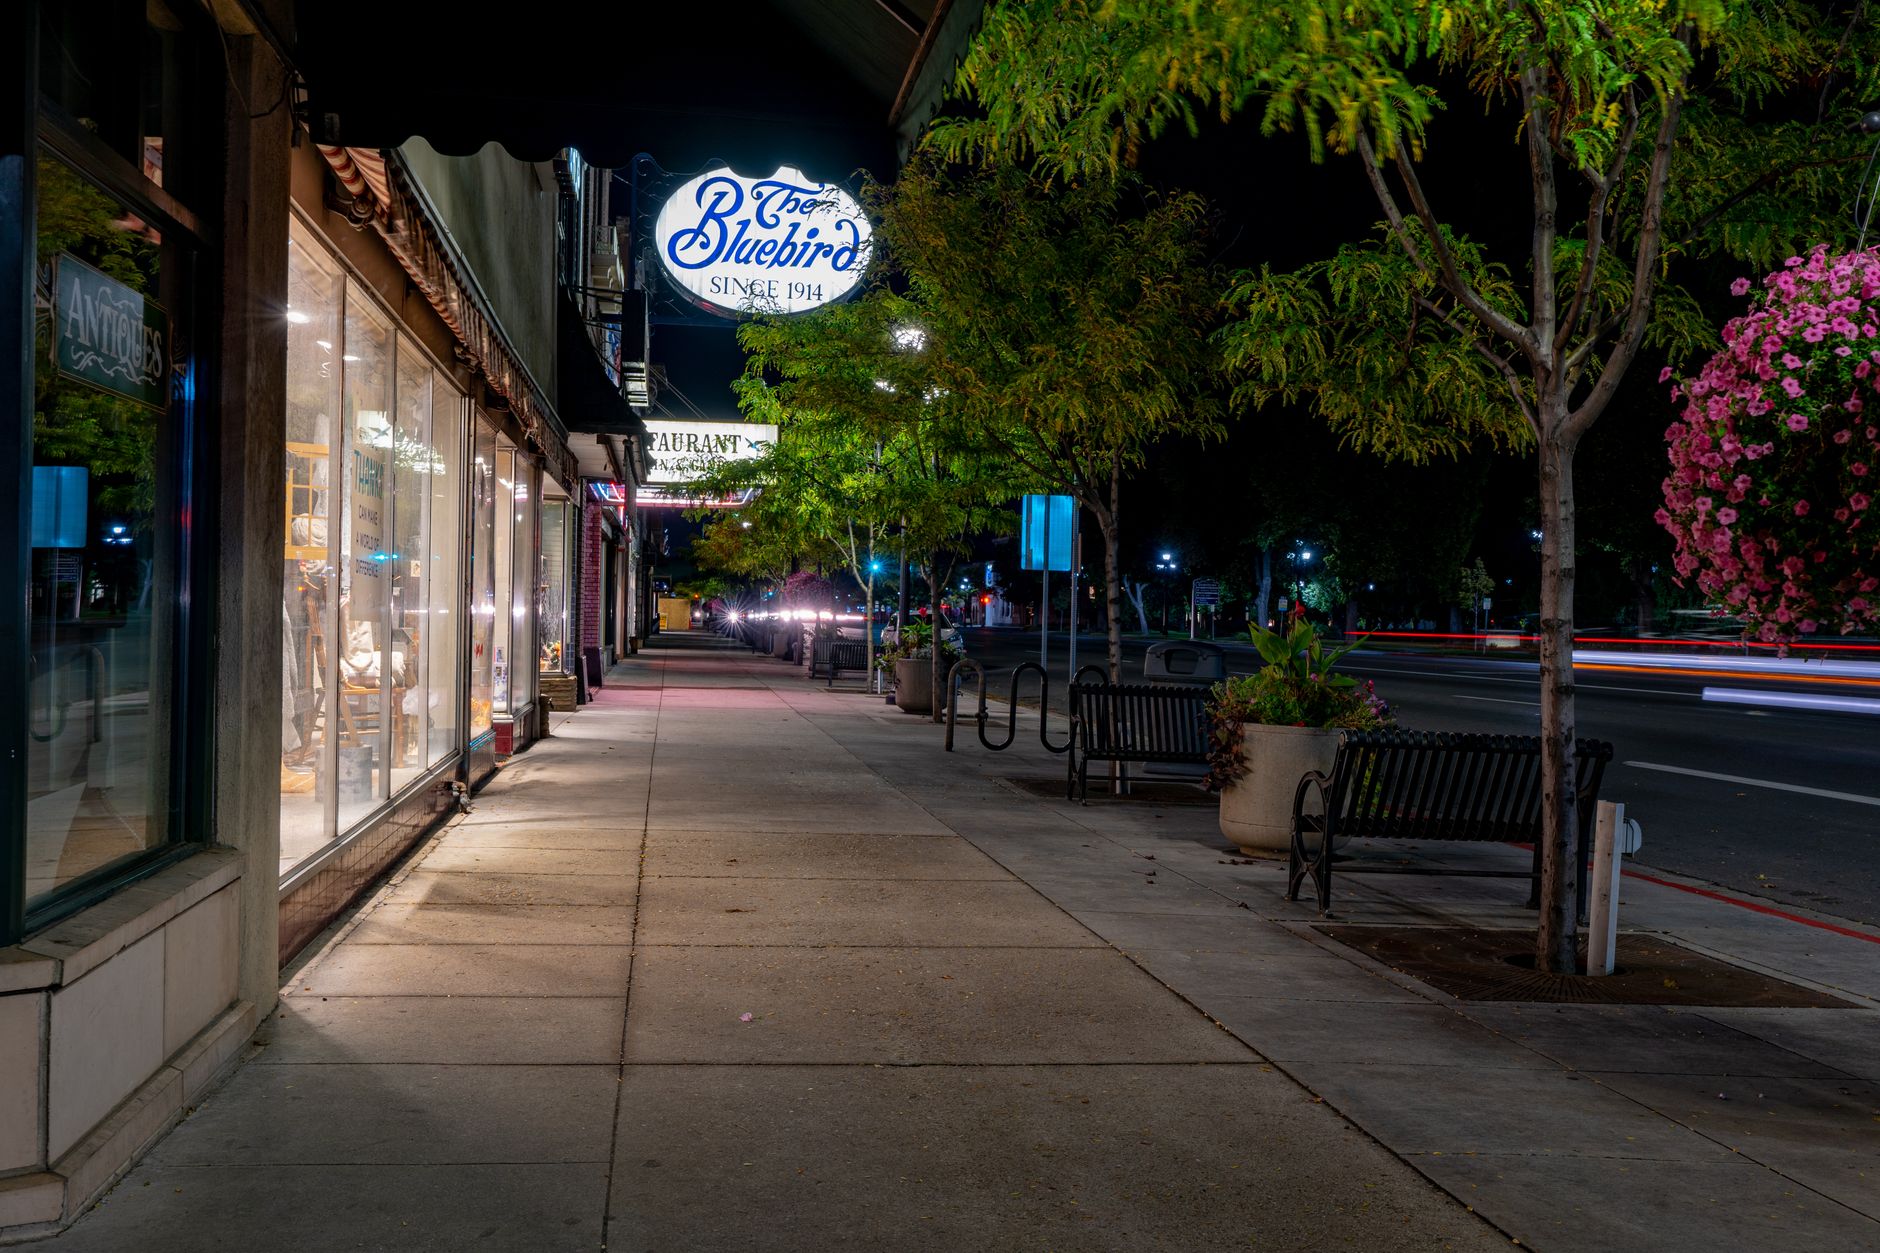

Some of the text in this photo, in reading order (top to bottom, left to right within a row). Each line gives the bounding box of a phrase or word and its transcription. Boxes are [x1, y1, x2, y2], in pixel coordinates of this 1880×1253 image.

[667, 176, 861, 272] Bluebird
[751, 180, 825, 229] The
[709, 275, 823, 301] SINCE 1914
